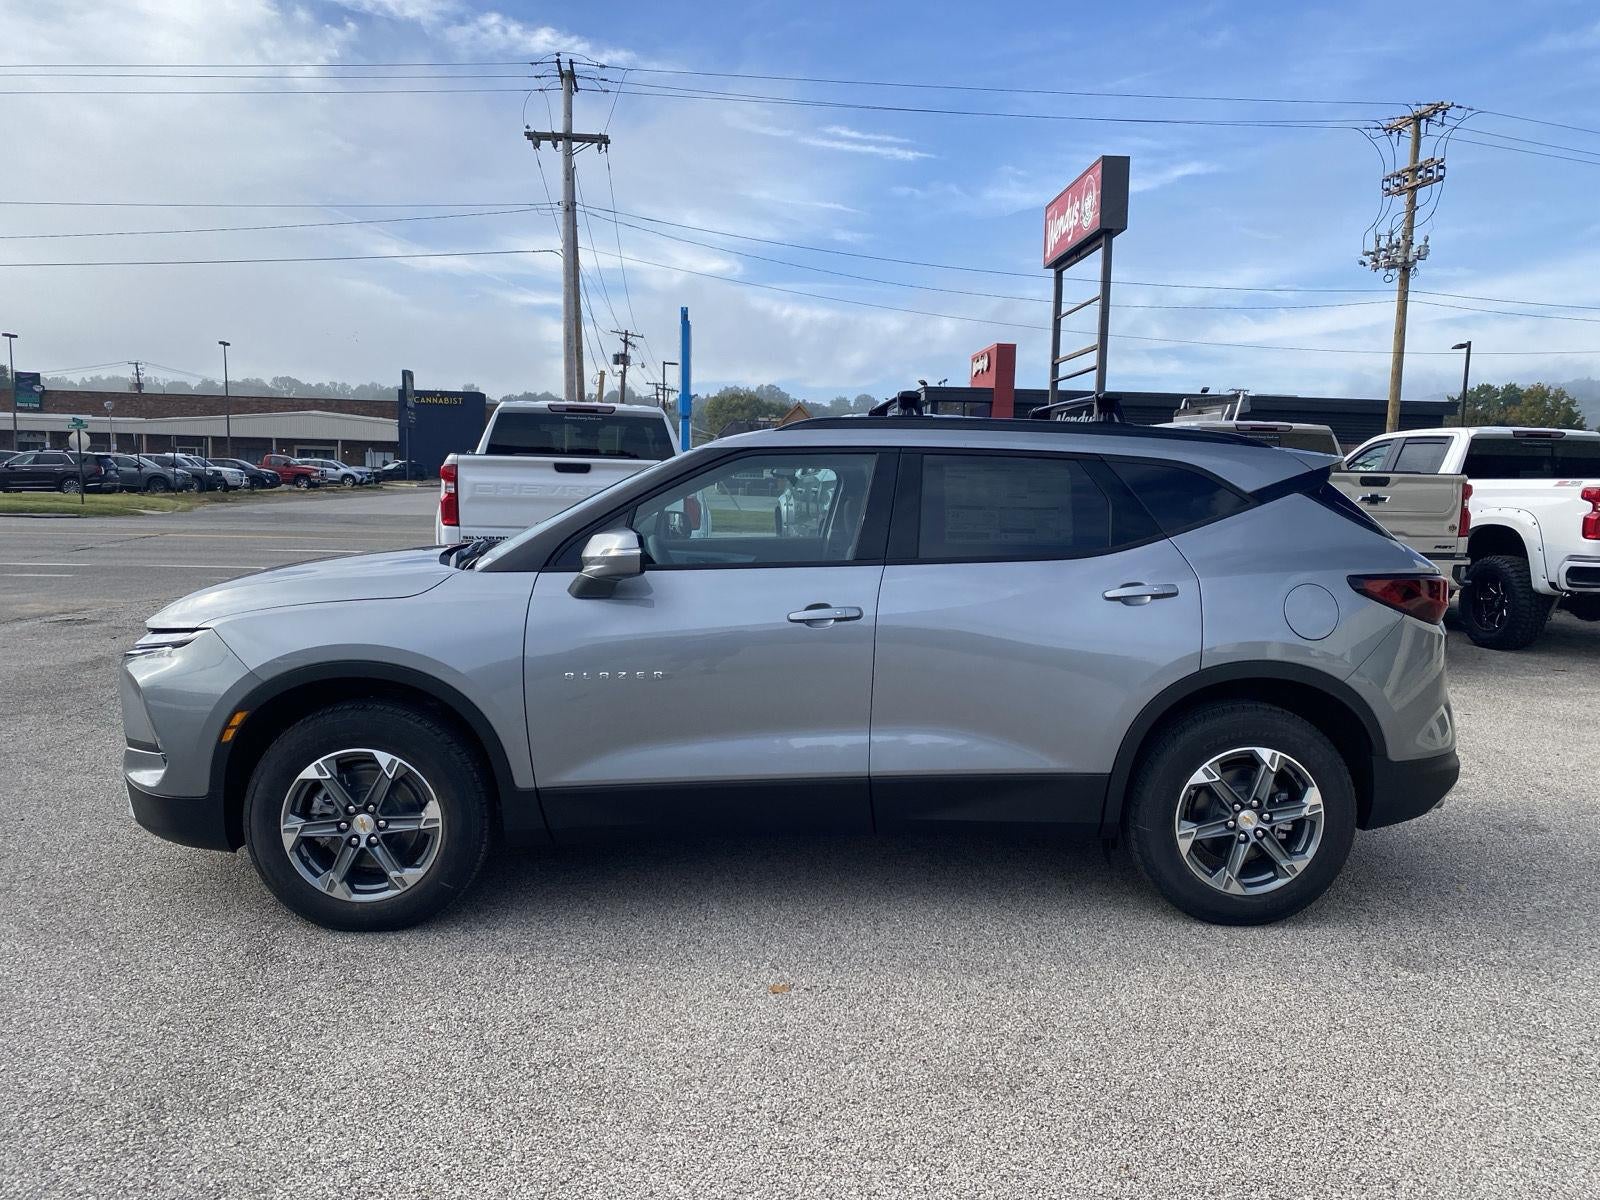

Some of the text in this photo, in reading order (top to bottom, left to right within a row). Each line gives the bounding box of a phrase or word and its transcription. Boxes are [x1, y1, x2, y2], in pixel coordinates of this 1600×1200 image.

[1046, 192, 1080, 258] Wendy's
[413, 396, 463, 405] CANNABIST
[564, 671, 663, 680] BLAZER
